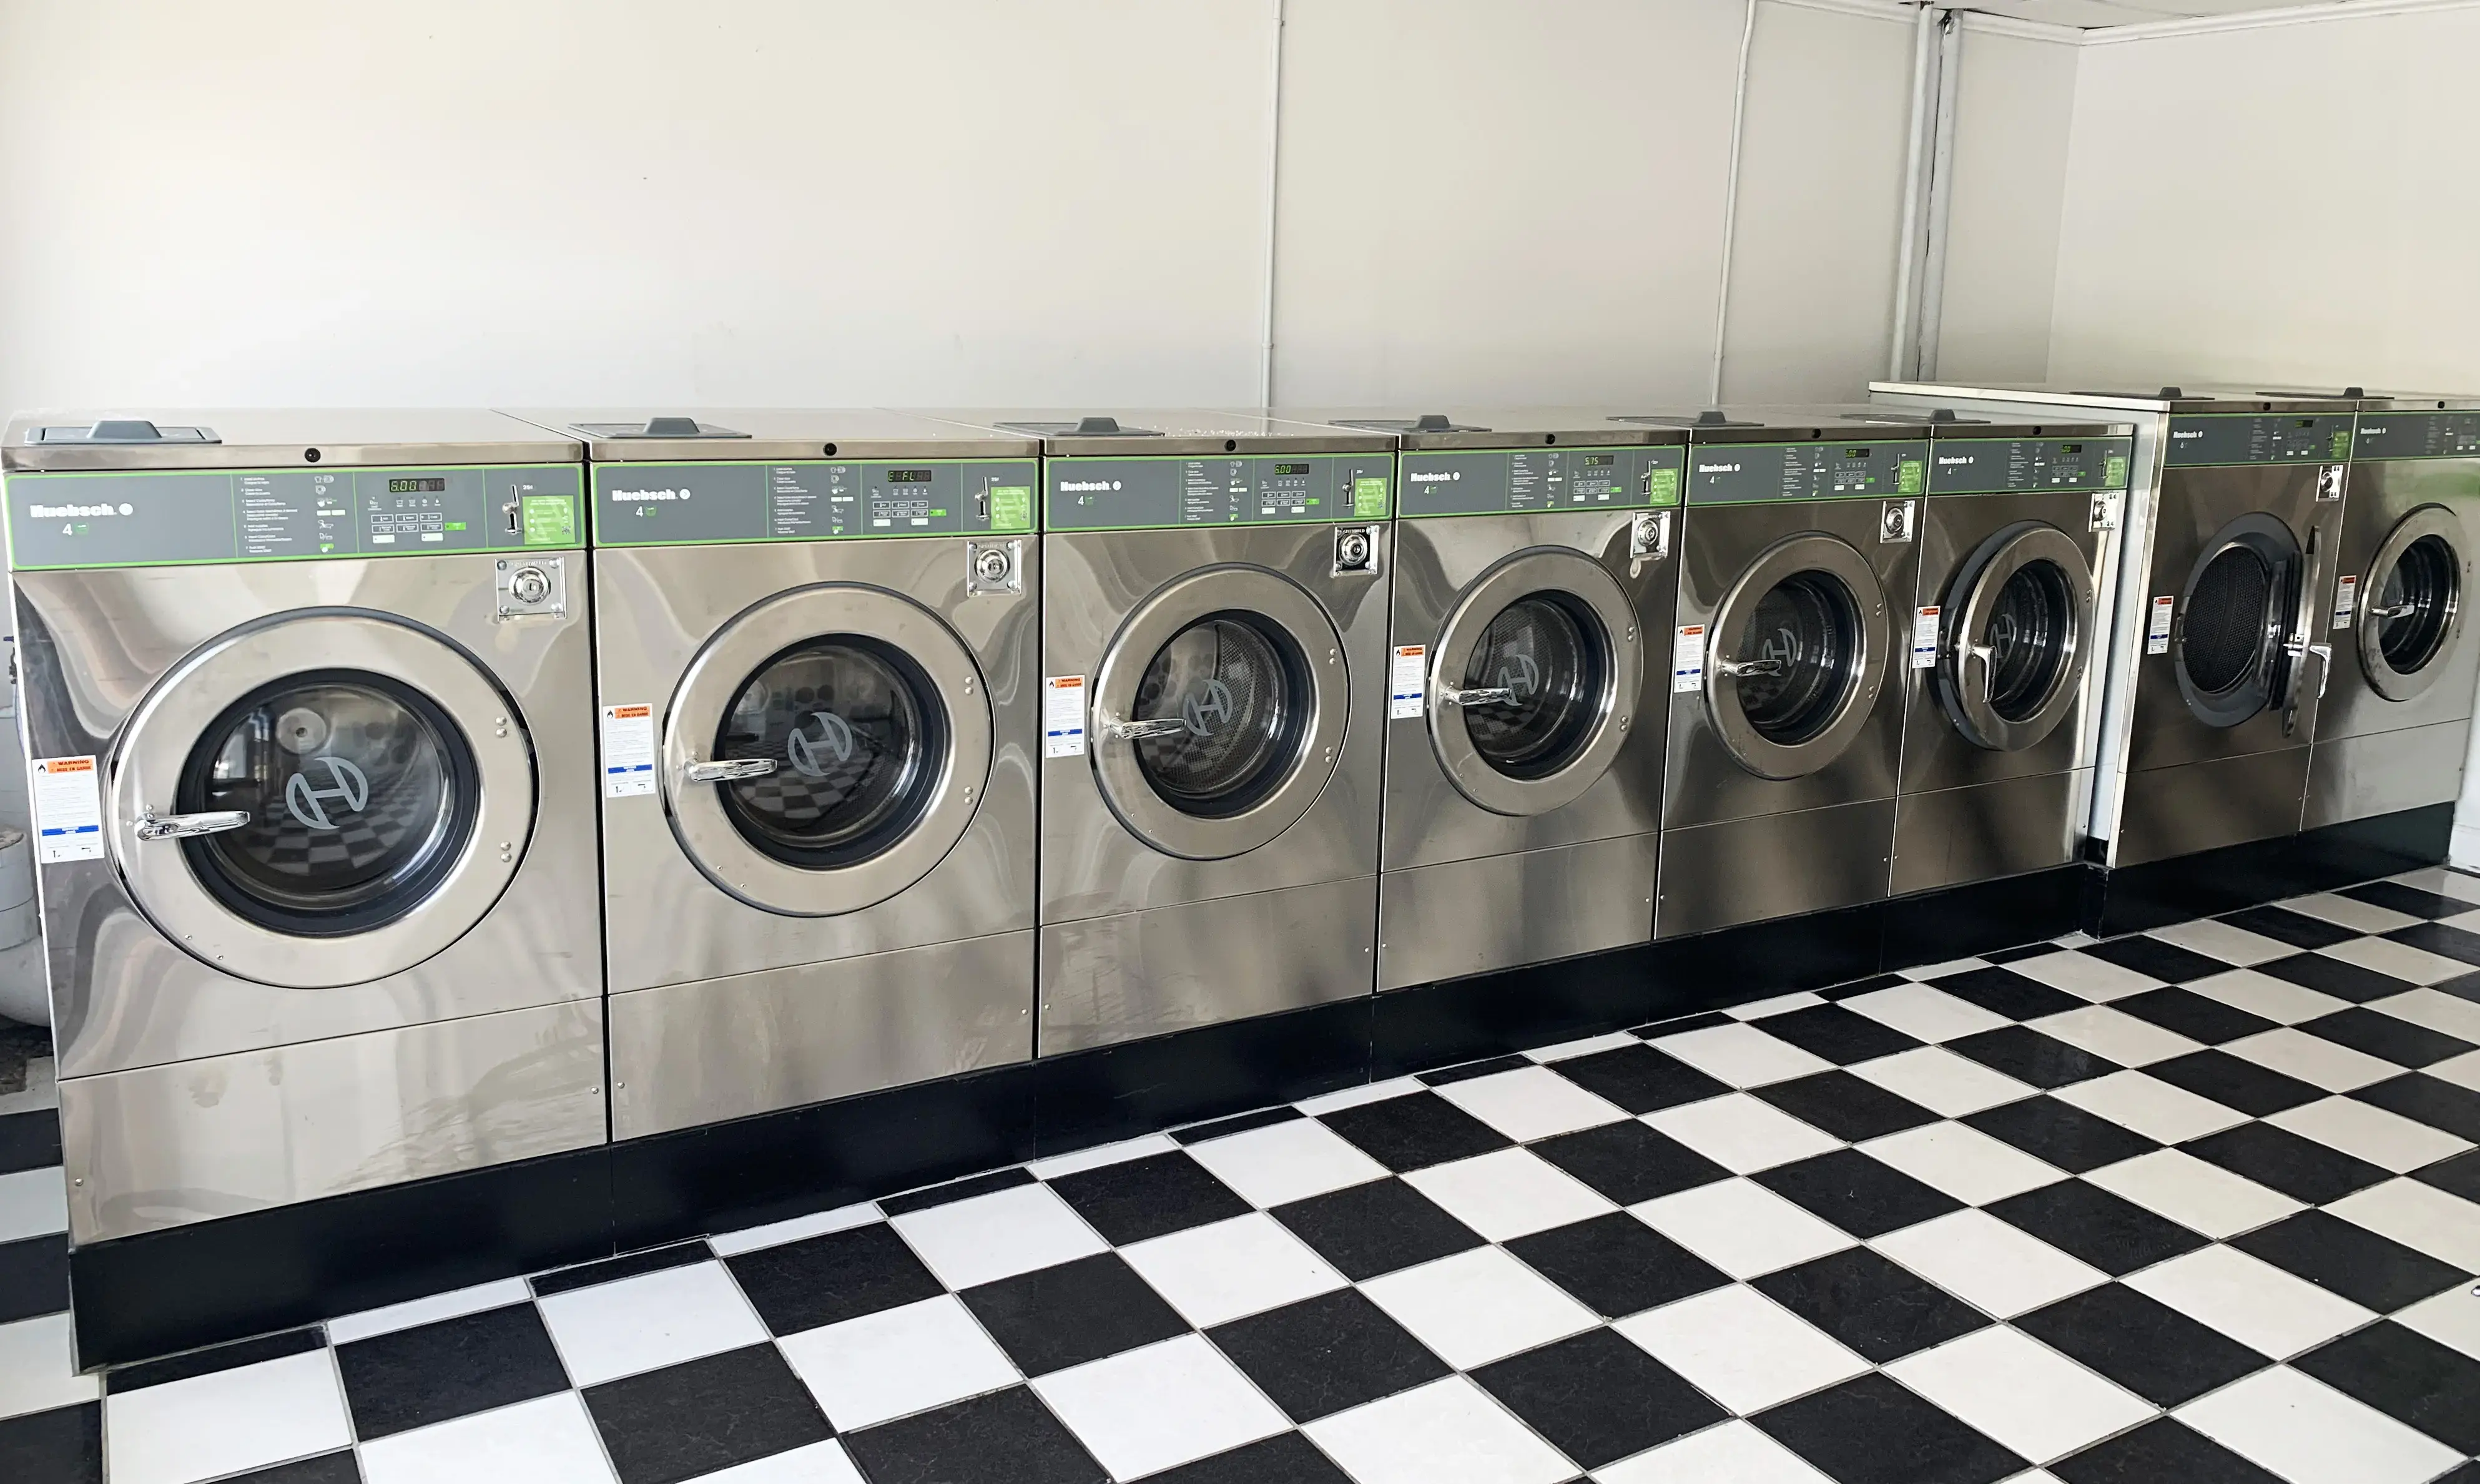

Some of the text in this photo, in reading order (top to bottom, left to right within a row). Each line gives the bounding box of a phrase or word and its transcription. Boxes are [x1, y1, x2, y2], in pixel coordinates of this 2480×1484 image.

[1698, 463, 1733, 473] Huebsch
[1410, 472, 1450, 482] Huebsch
[1710, 476, 1715, 484] 4
[1060, 481, 1110, 491] Huebsch
[1424, 485, 1430, 494] 4
[612, 489, 676, 501] Huebsch
[1078, 496, 1085, 506] 4
[29, 503, 115, 518] Huebsch
[636, 506, 644, 517] 4
[62, 523, 73, 536] 4
